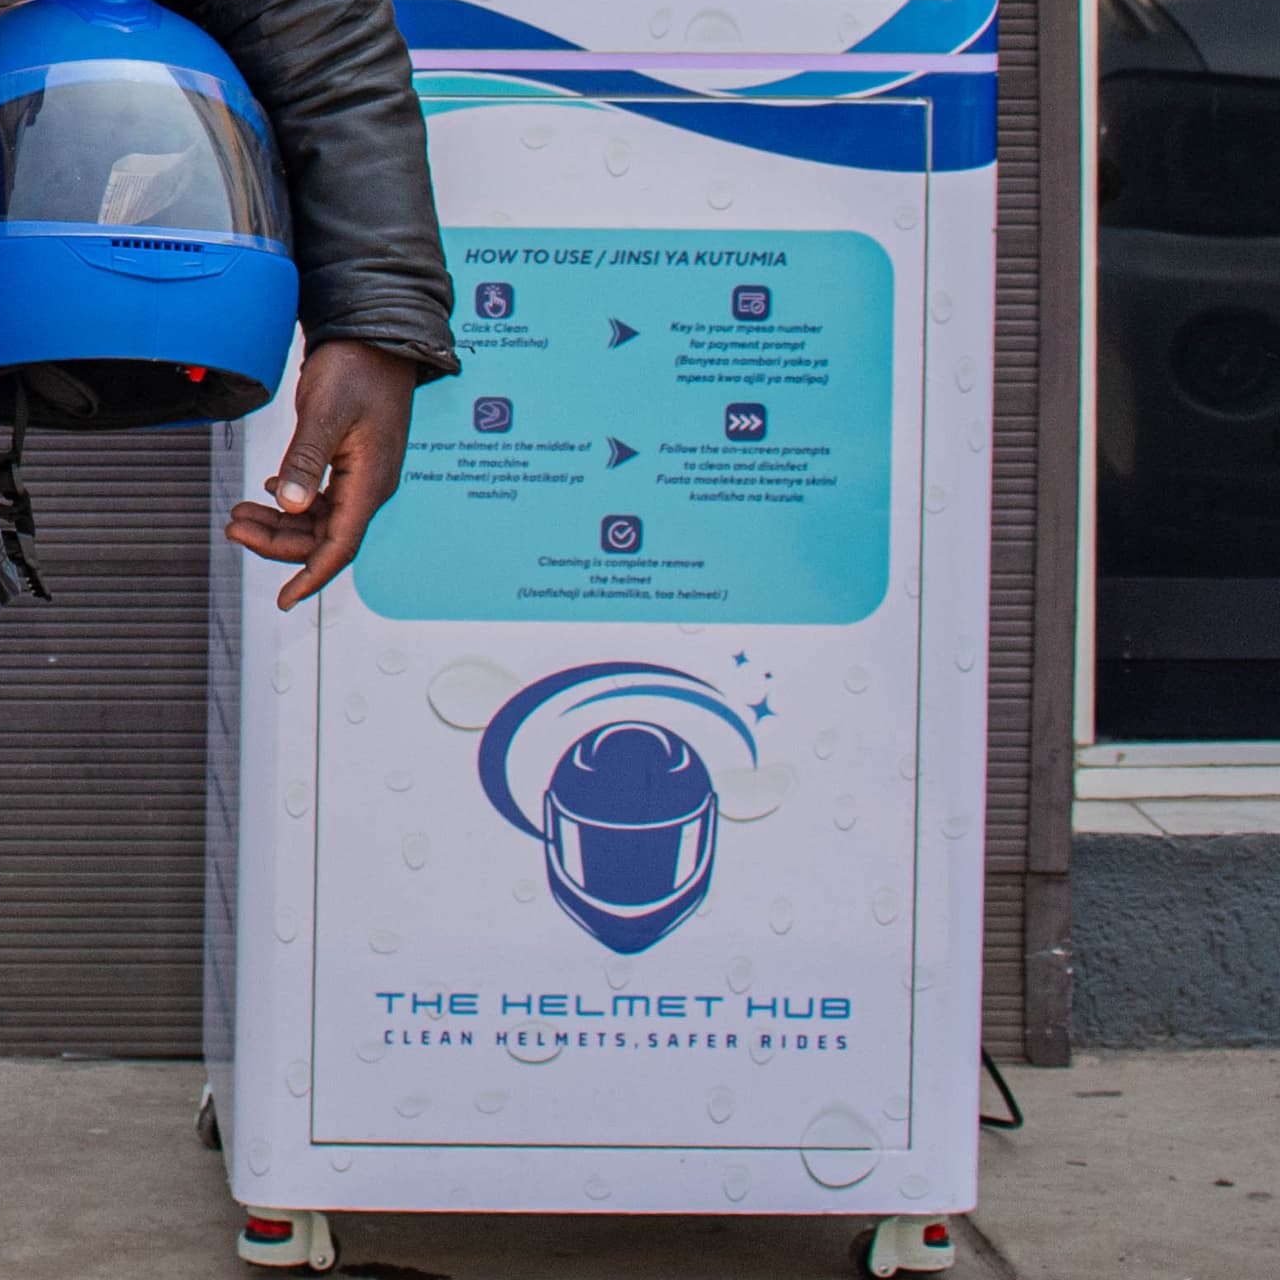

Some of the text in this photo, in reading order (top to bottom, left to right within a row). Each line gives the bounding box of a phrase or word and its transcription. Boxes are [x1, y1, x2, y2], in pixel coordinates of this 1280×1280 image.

[465, 248, 519, 265] HOW
[522, 249, 550, 265] TO
[554, 249, 593, 265] USE
[609, 250, 660, 266] JINSI
[665, 250, 689, 266] YA
[693, 250, 787, 267] KUTUMIA
[462, 323, 529, 333] Click Clean
[670, 322, 823, 335] Key in your mpesa number
[690, 339, 805, 352] for payment prompt
[813, 358, 829, 368] ya
[767, 375, 782, 385] ya
[429, 443, 455, 453] your
[458, 441, 499, 451] helmet
[502, 441, 512, 451] in
[515, 441, 533, 451] the
[536, 441, 574, 452] middle
[578, 441, 592, 452] of
[659, 443, 831, 457] Follow the on-screen prompts
[458, 458, 529, 468] the machine
[684, 461, 808, 471] to clean and disinfect
[569, 474, 584, 485] ya
[538, 556, 705, 569] Cleaning is complete remove
[589, 575, 652, 585] the helmet
[374, 991, 851, 1019] THE HELMET HUB
[383, 1029, 473, 1046] CLEAN
[760, 1033, 847, 1050] RIDES
